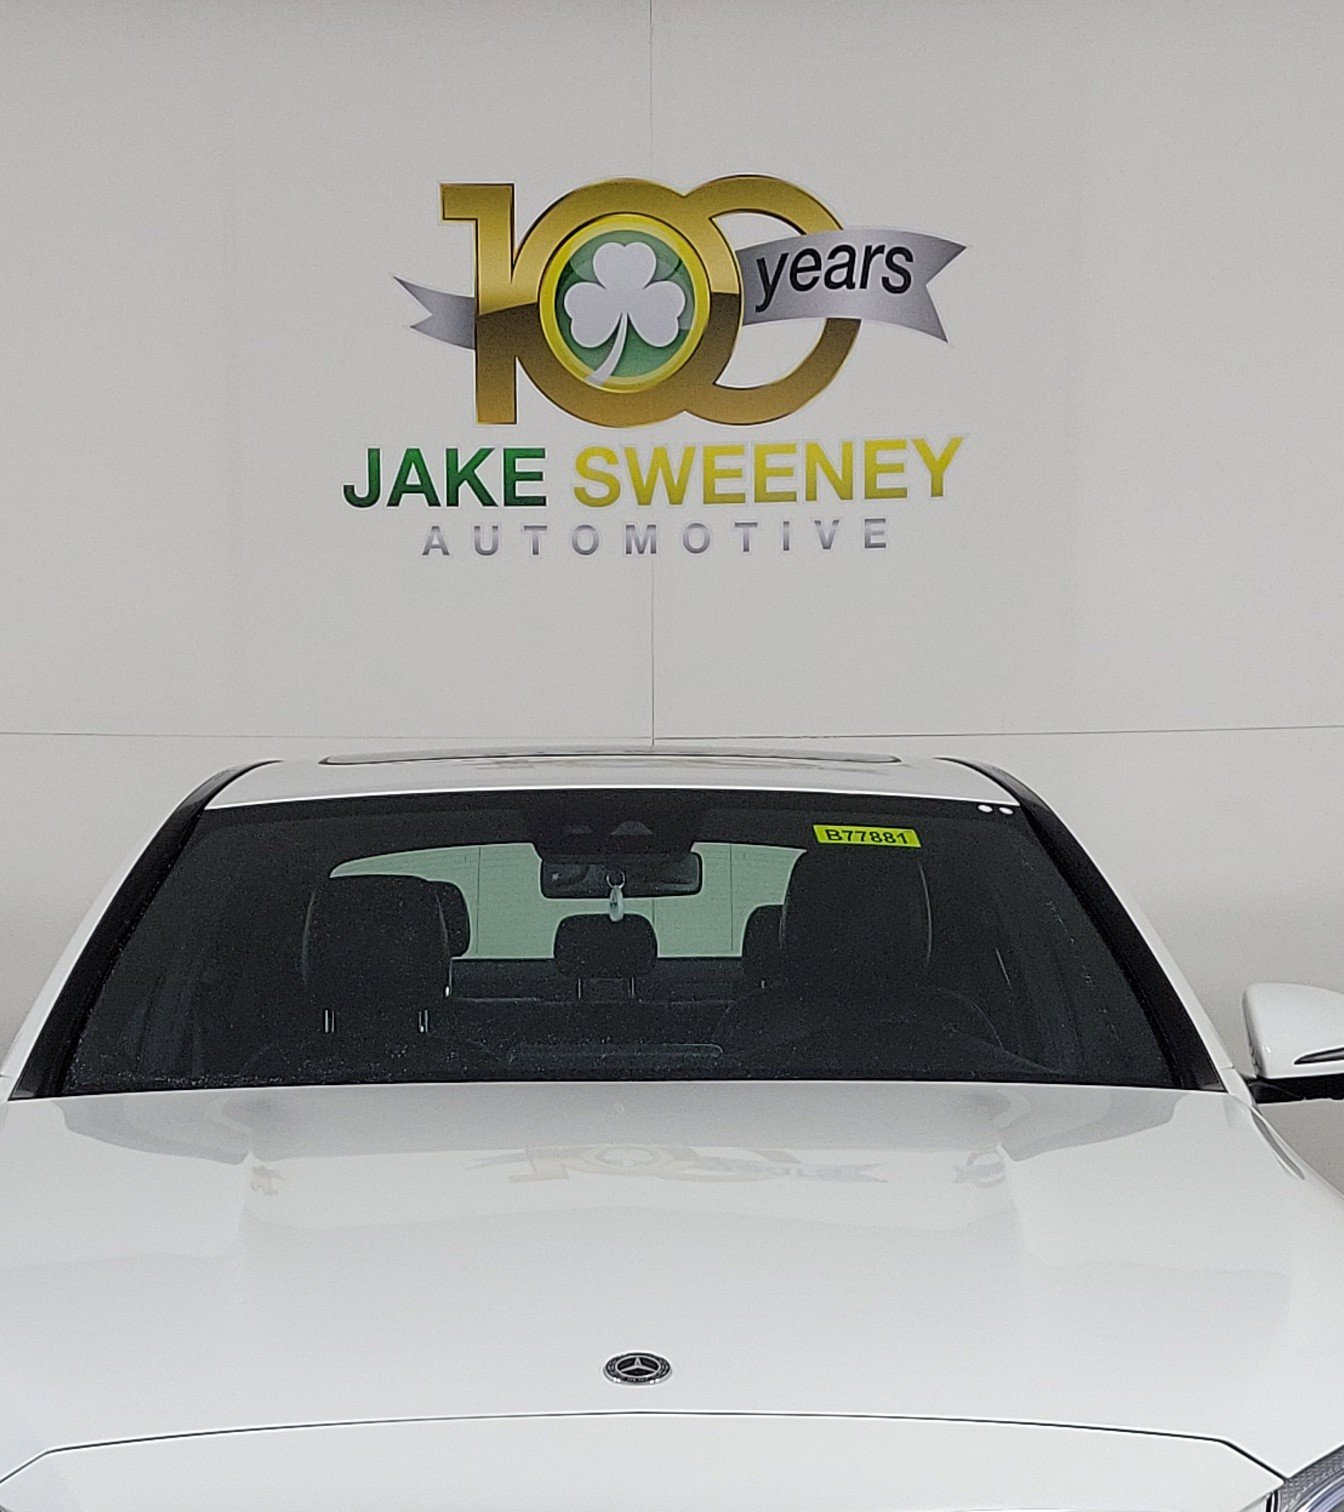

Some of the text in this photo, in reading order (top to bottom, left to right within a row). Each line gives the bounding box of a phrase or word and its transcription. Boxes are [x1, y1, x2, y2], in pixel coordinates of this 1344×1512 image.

[439, 174, 914, 428] 100 years
[343, 436, 964, 509] JAKE SWEENEY
[421, 517, 888, 557] AUTOMOTIVE
[824, 828, 908, 845] B77881
